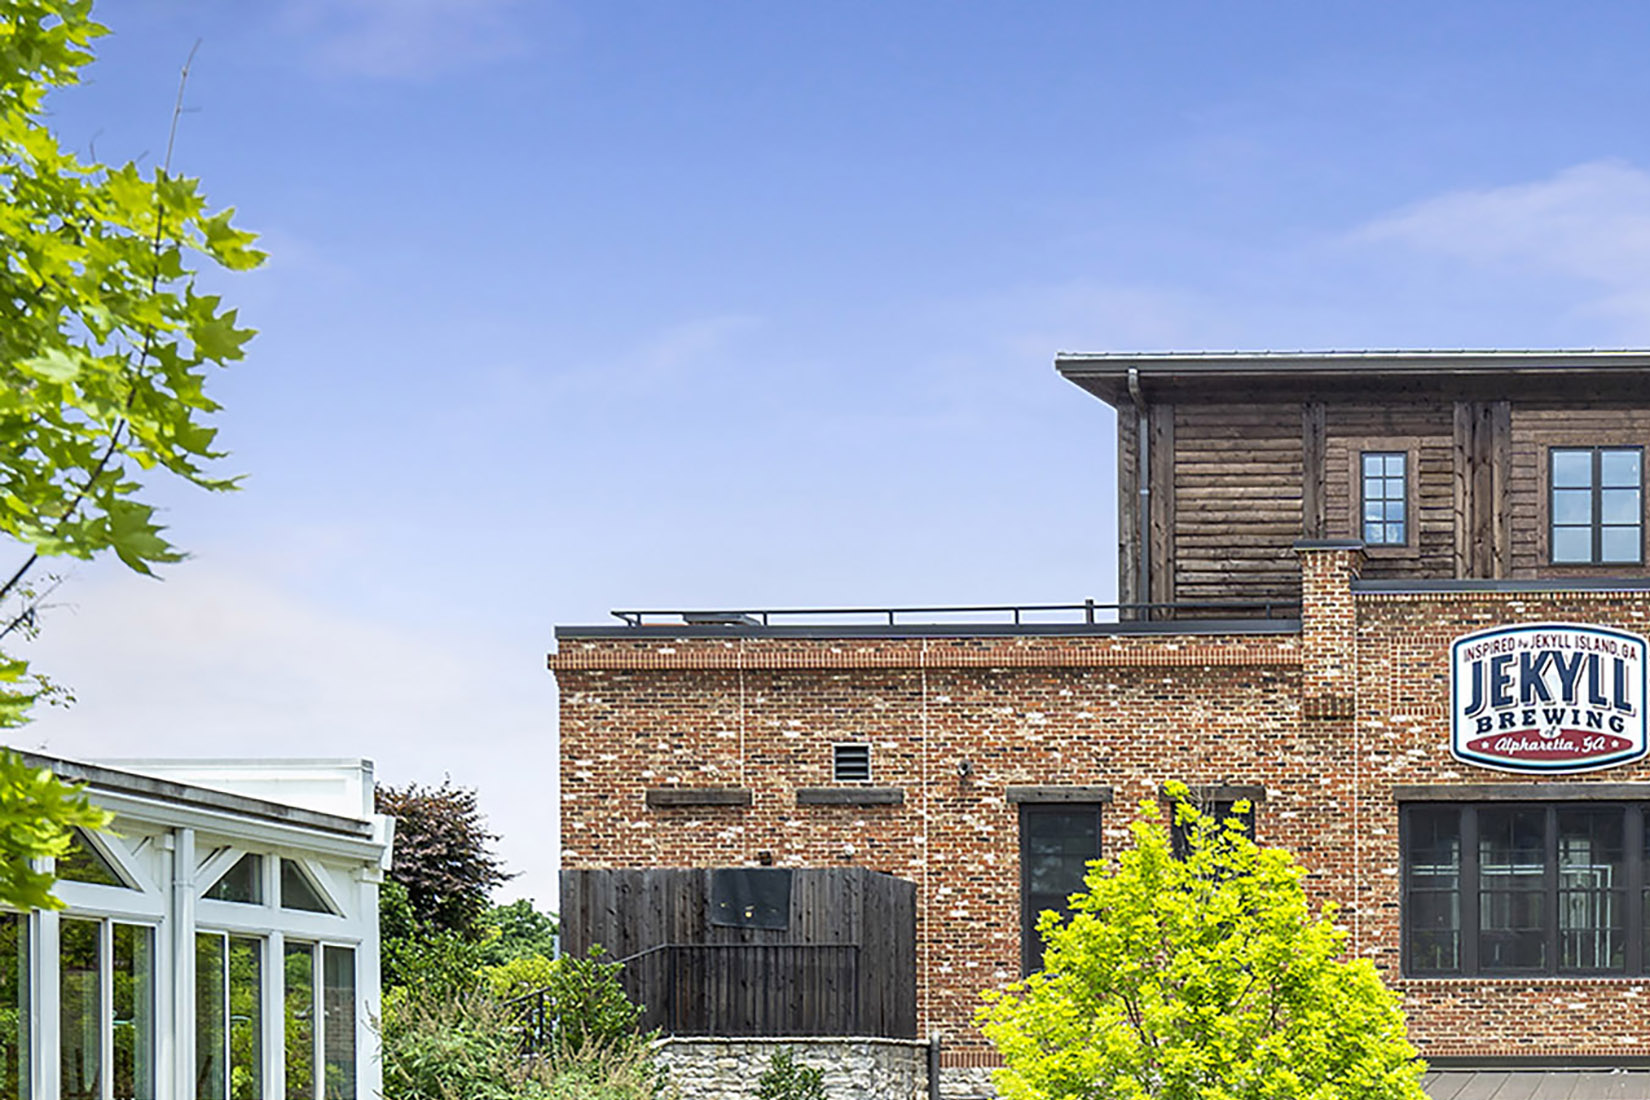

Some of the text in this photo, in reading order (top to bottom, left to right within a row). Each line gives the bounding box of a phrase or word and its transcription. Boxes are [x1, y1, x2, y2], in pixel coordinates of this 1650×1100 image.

[1463, 637, 1515, 662] INSPIRED
[1530, 634, 1571, 649] JEKYLL
[1623, 646, 1637, 660] GA
[1464, 651, 1636, 719] JEKYLL
[1476, 708, 1625, 734] BREWING
[1581, 736, 1606, 752] GA
